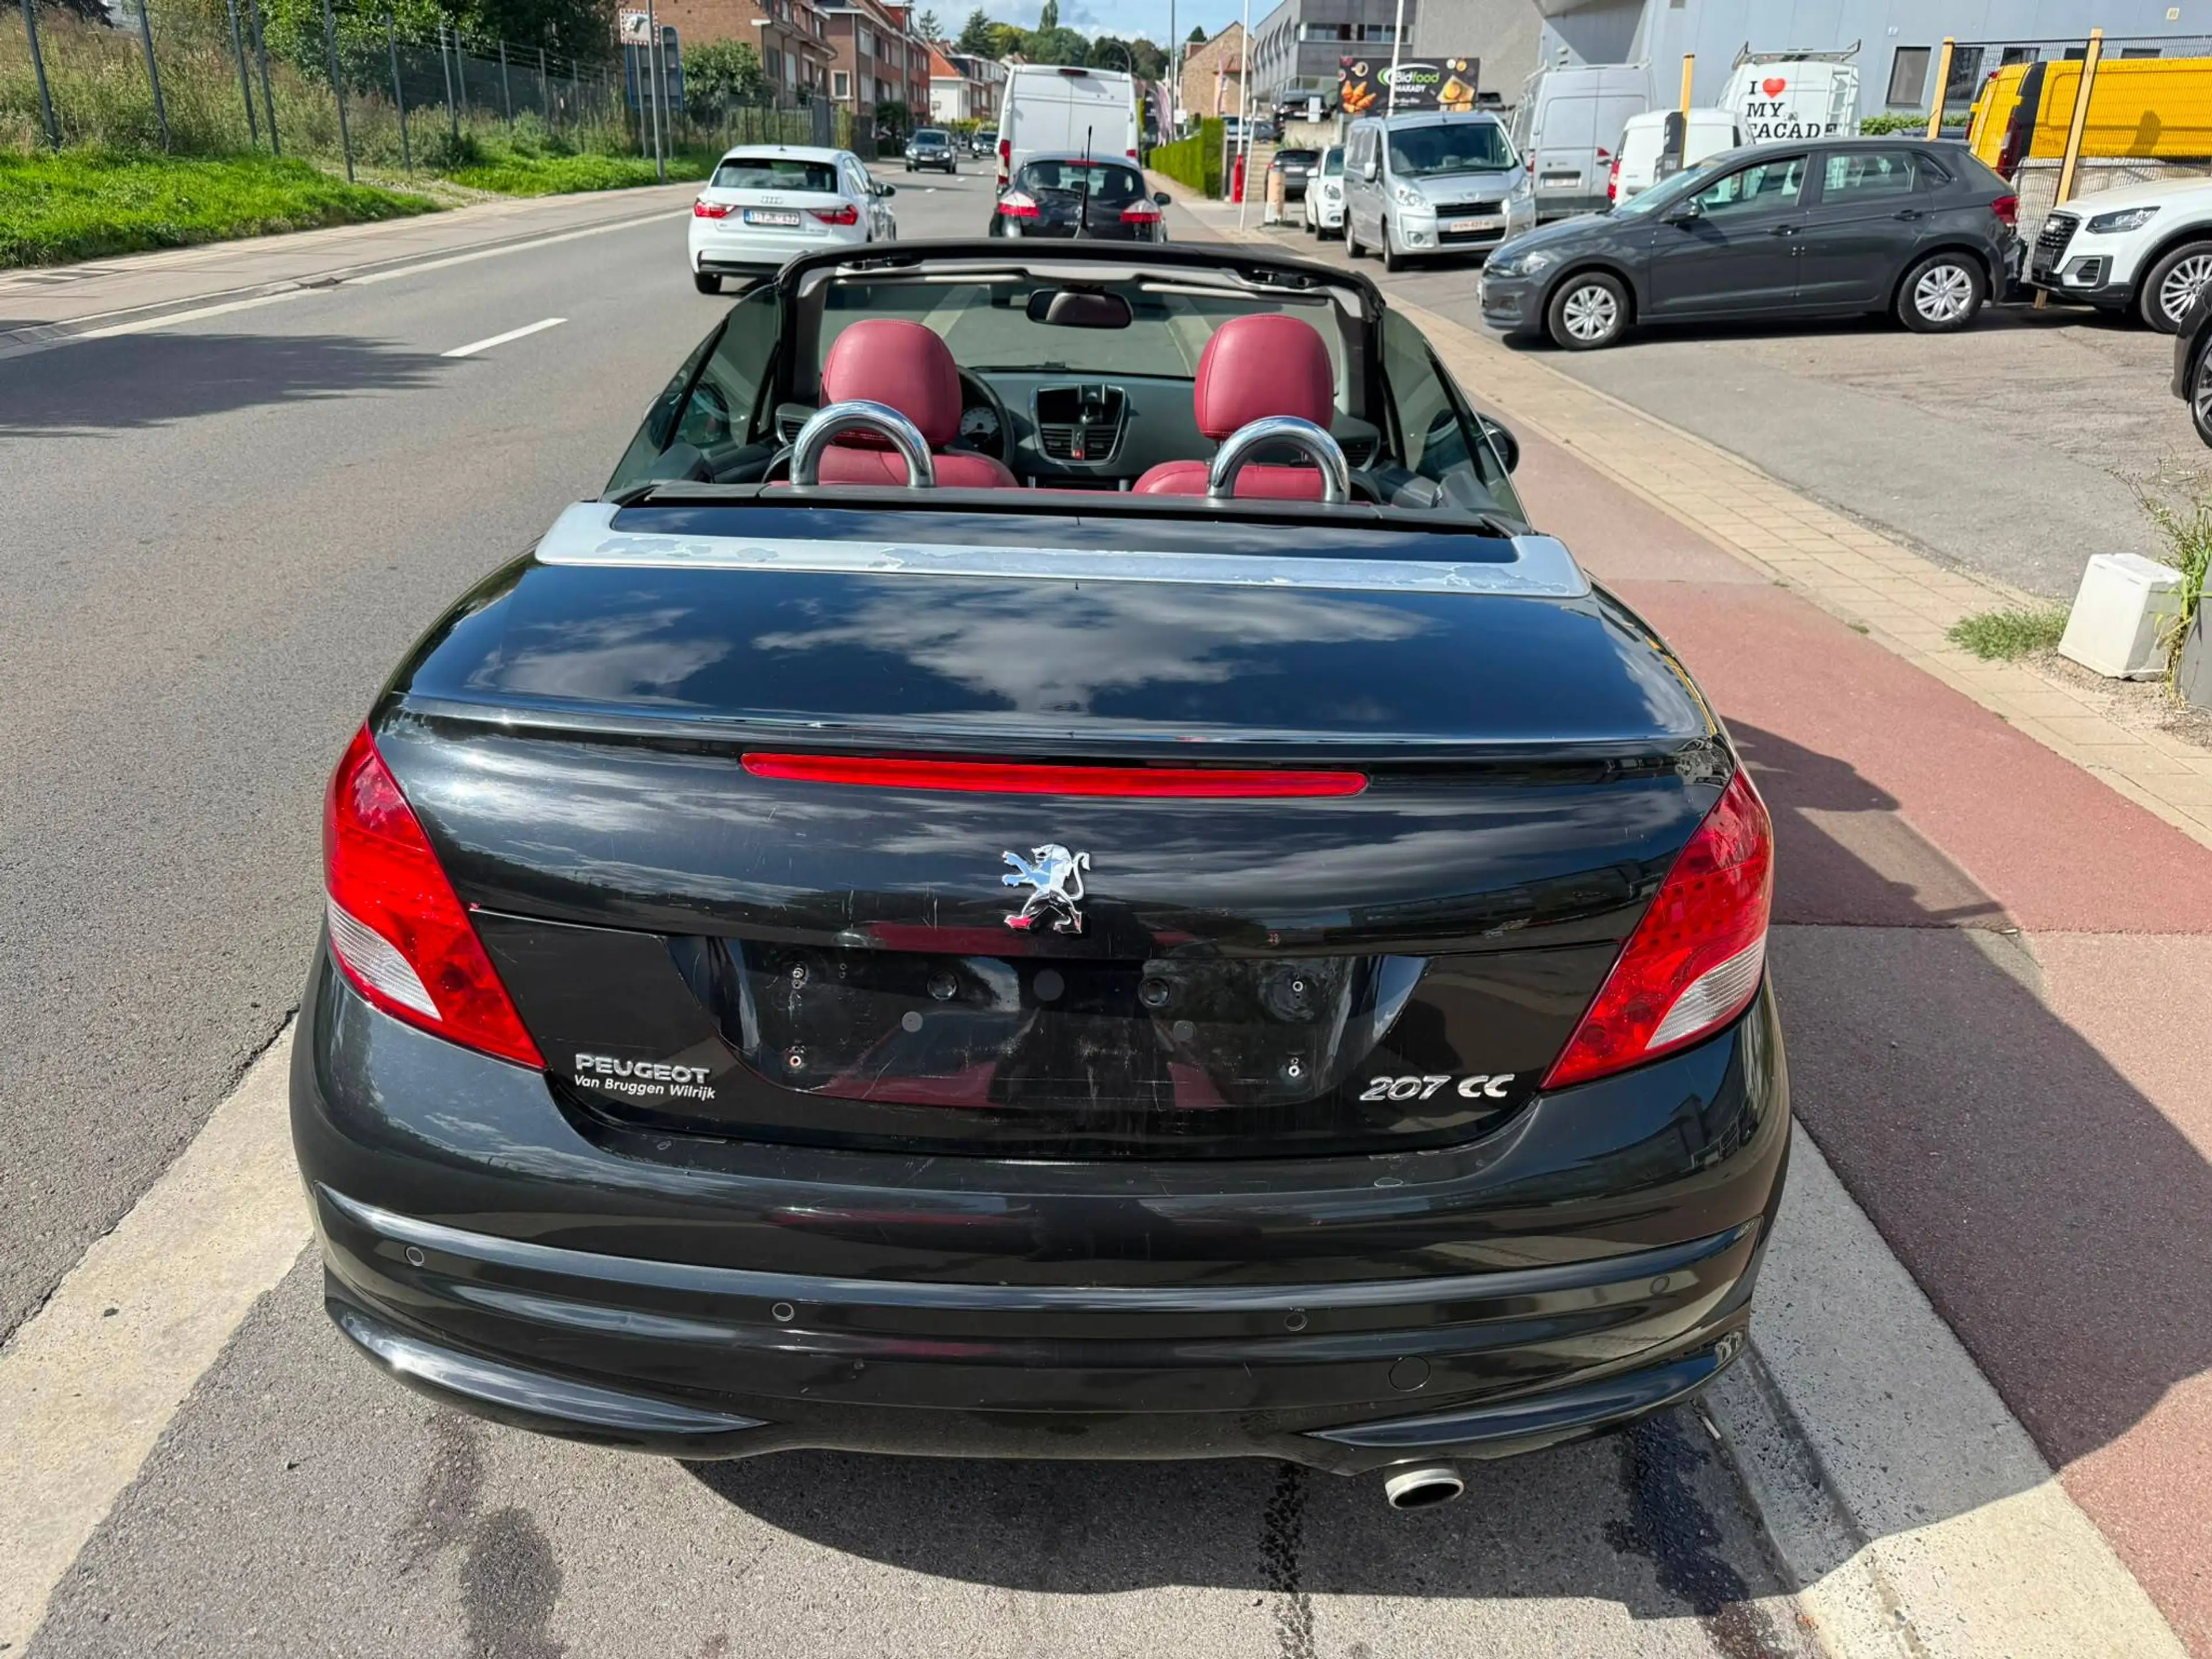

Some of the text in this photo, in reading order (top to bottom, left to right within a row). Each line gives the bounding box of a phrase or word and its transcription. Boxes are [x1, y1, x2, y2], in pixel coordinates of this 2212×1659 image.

[1395, 71, 1440, 84] Bidfood
[1749, 81, 1758, 95] I
[1747, 103, 1785, 118] MY
[575, 1053, 710, 1084] PEUGEOT
[574, 1074, 716, 1101] Van Bruggen Wilrijk
[1359, 1073, 1516, 1101] 207 CC
